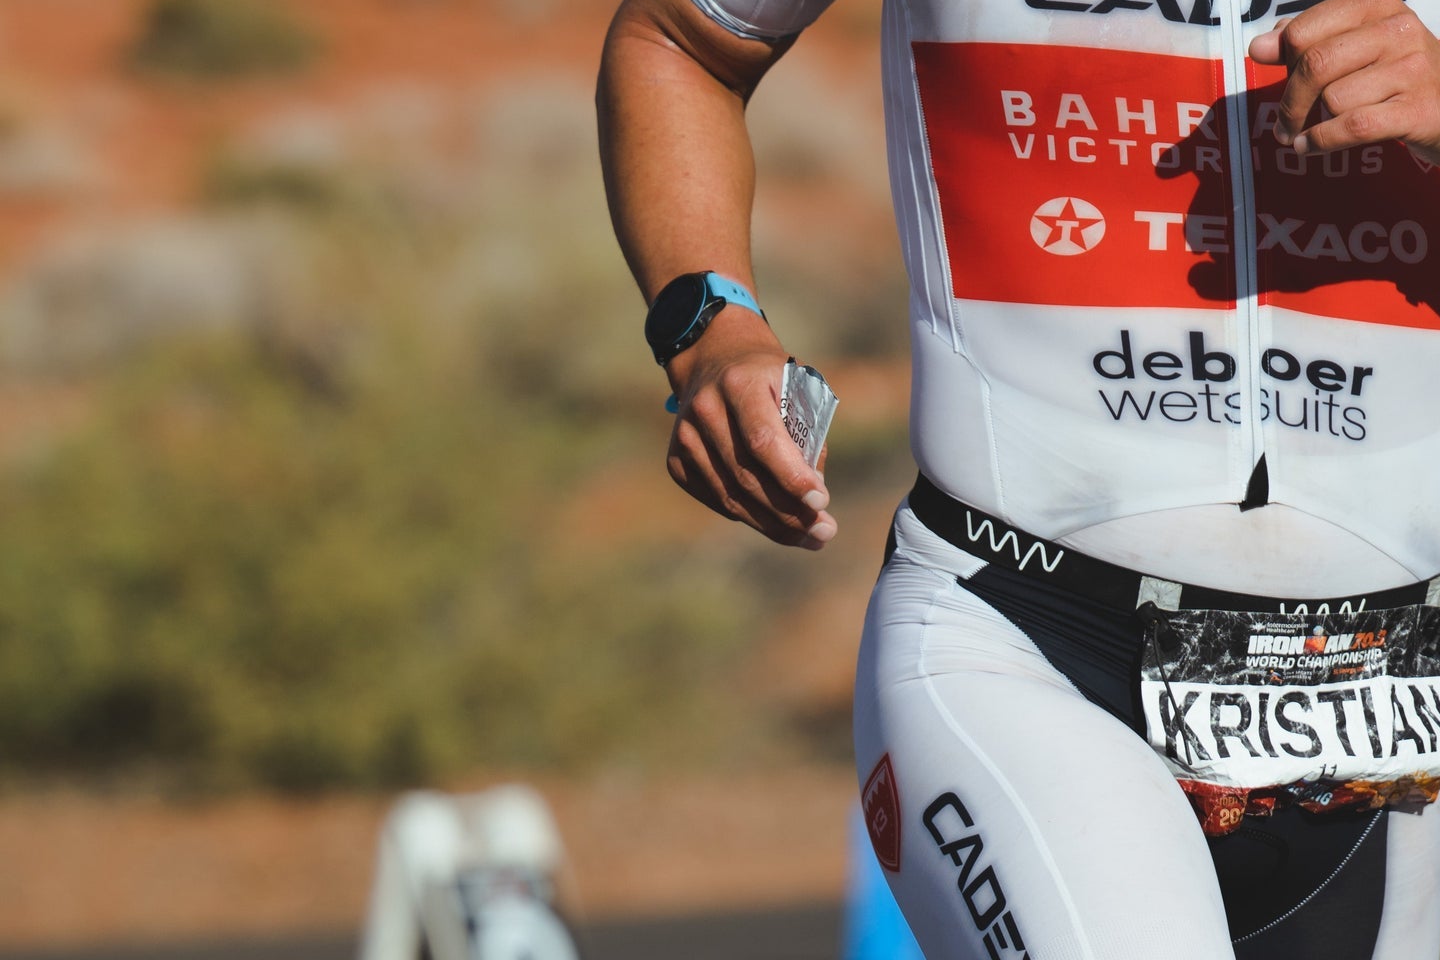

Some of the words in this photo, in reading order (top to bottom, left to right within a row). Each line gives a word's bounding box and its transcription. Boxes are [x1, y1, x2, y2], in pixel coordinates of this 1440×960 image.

[1008, 131, 1385, 178] VICTORIOUS
[1133, 209, 1429, 264] TEXACO
[1092, 329, 1373, 396] deboer
[1098, 383, 1367, 441] wetsuits
[1246, 654, 1296, 669] WORLD
[1296, 648, 1383, 669] CHAMPIONSHIP
[922, 791, 1031, 960] CADE
